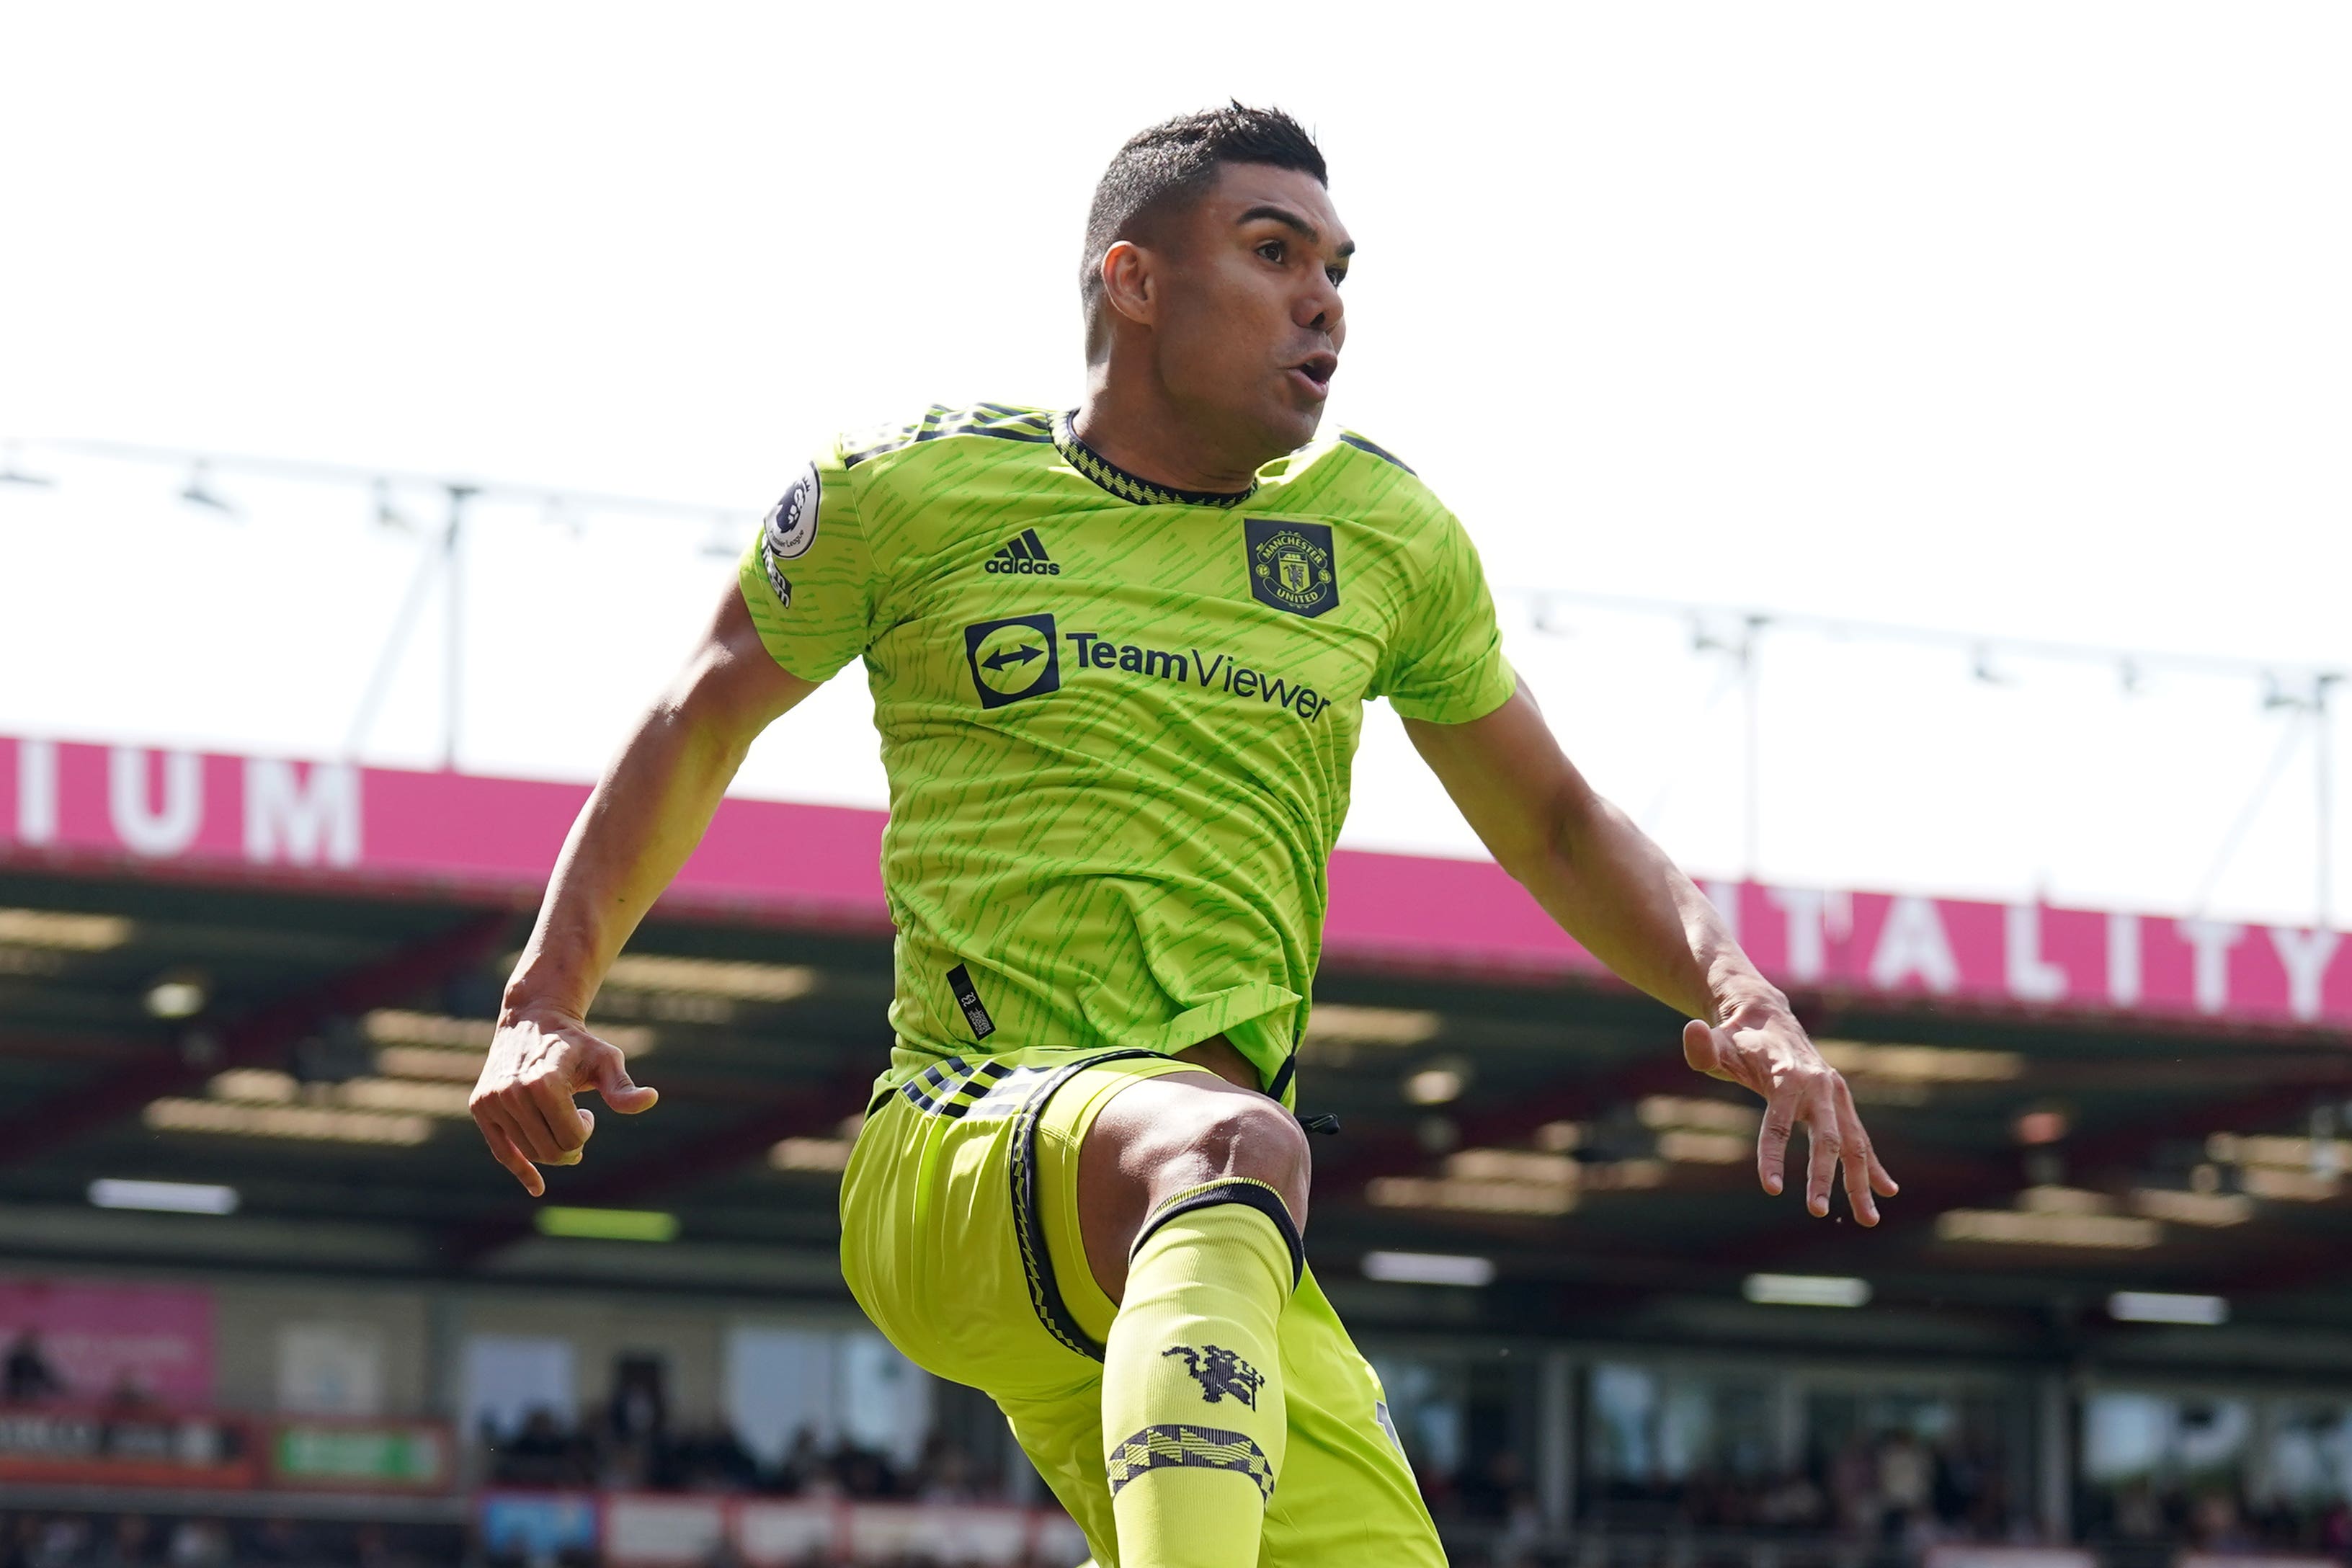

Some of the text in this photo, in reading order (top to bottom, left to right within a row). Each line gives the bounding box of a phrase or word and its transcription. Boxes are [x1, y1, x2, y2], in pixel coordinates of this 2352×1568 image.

[785, 530, 804, 547] League
[1262, 535, 1324, 564] MANCHESTER
[984, 555, 1060, 575] adidas
[1276, 588, 1318, 603] UNITED
[1066, 633, 1332, 723] TeamViewer
[17, 739, 362, 868] IUM
